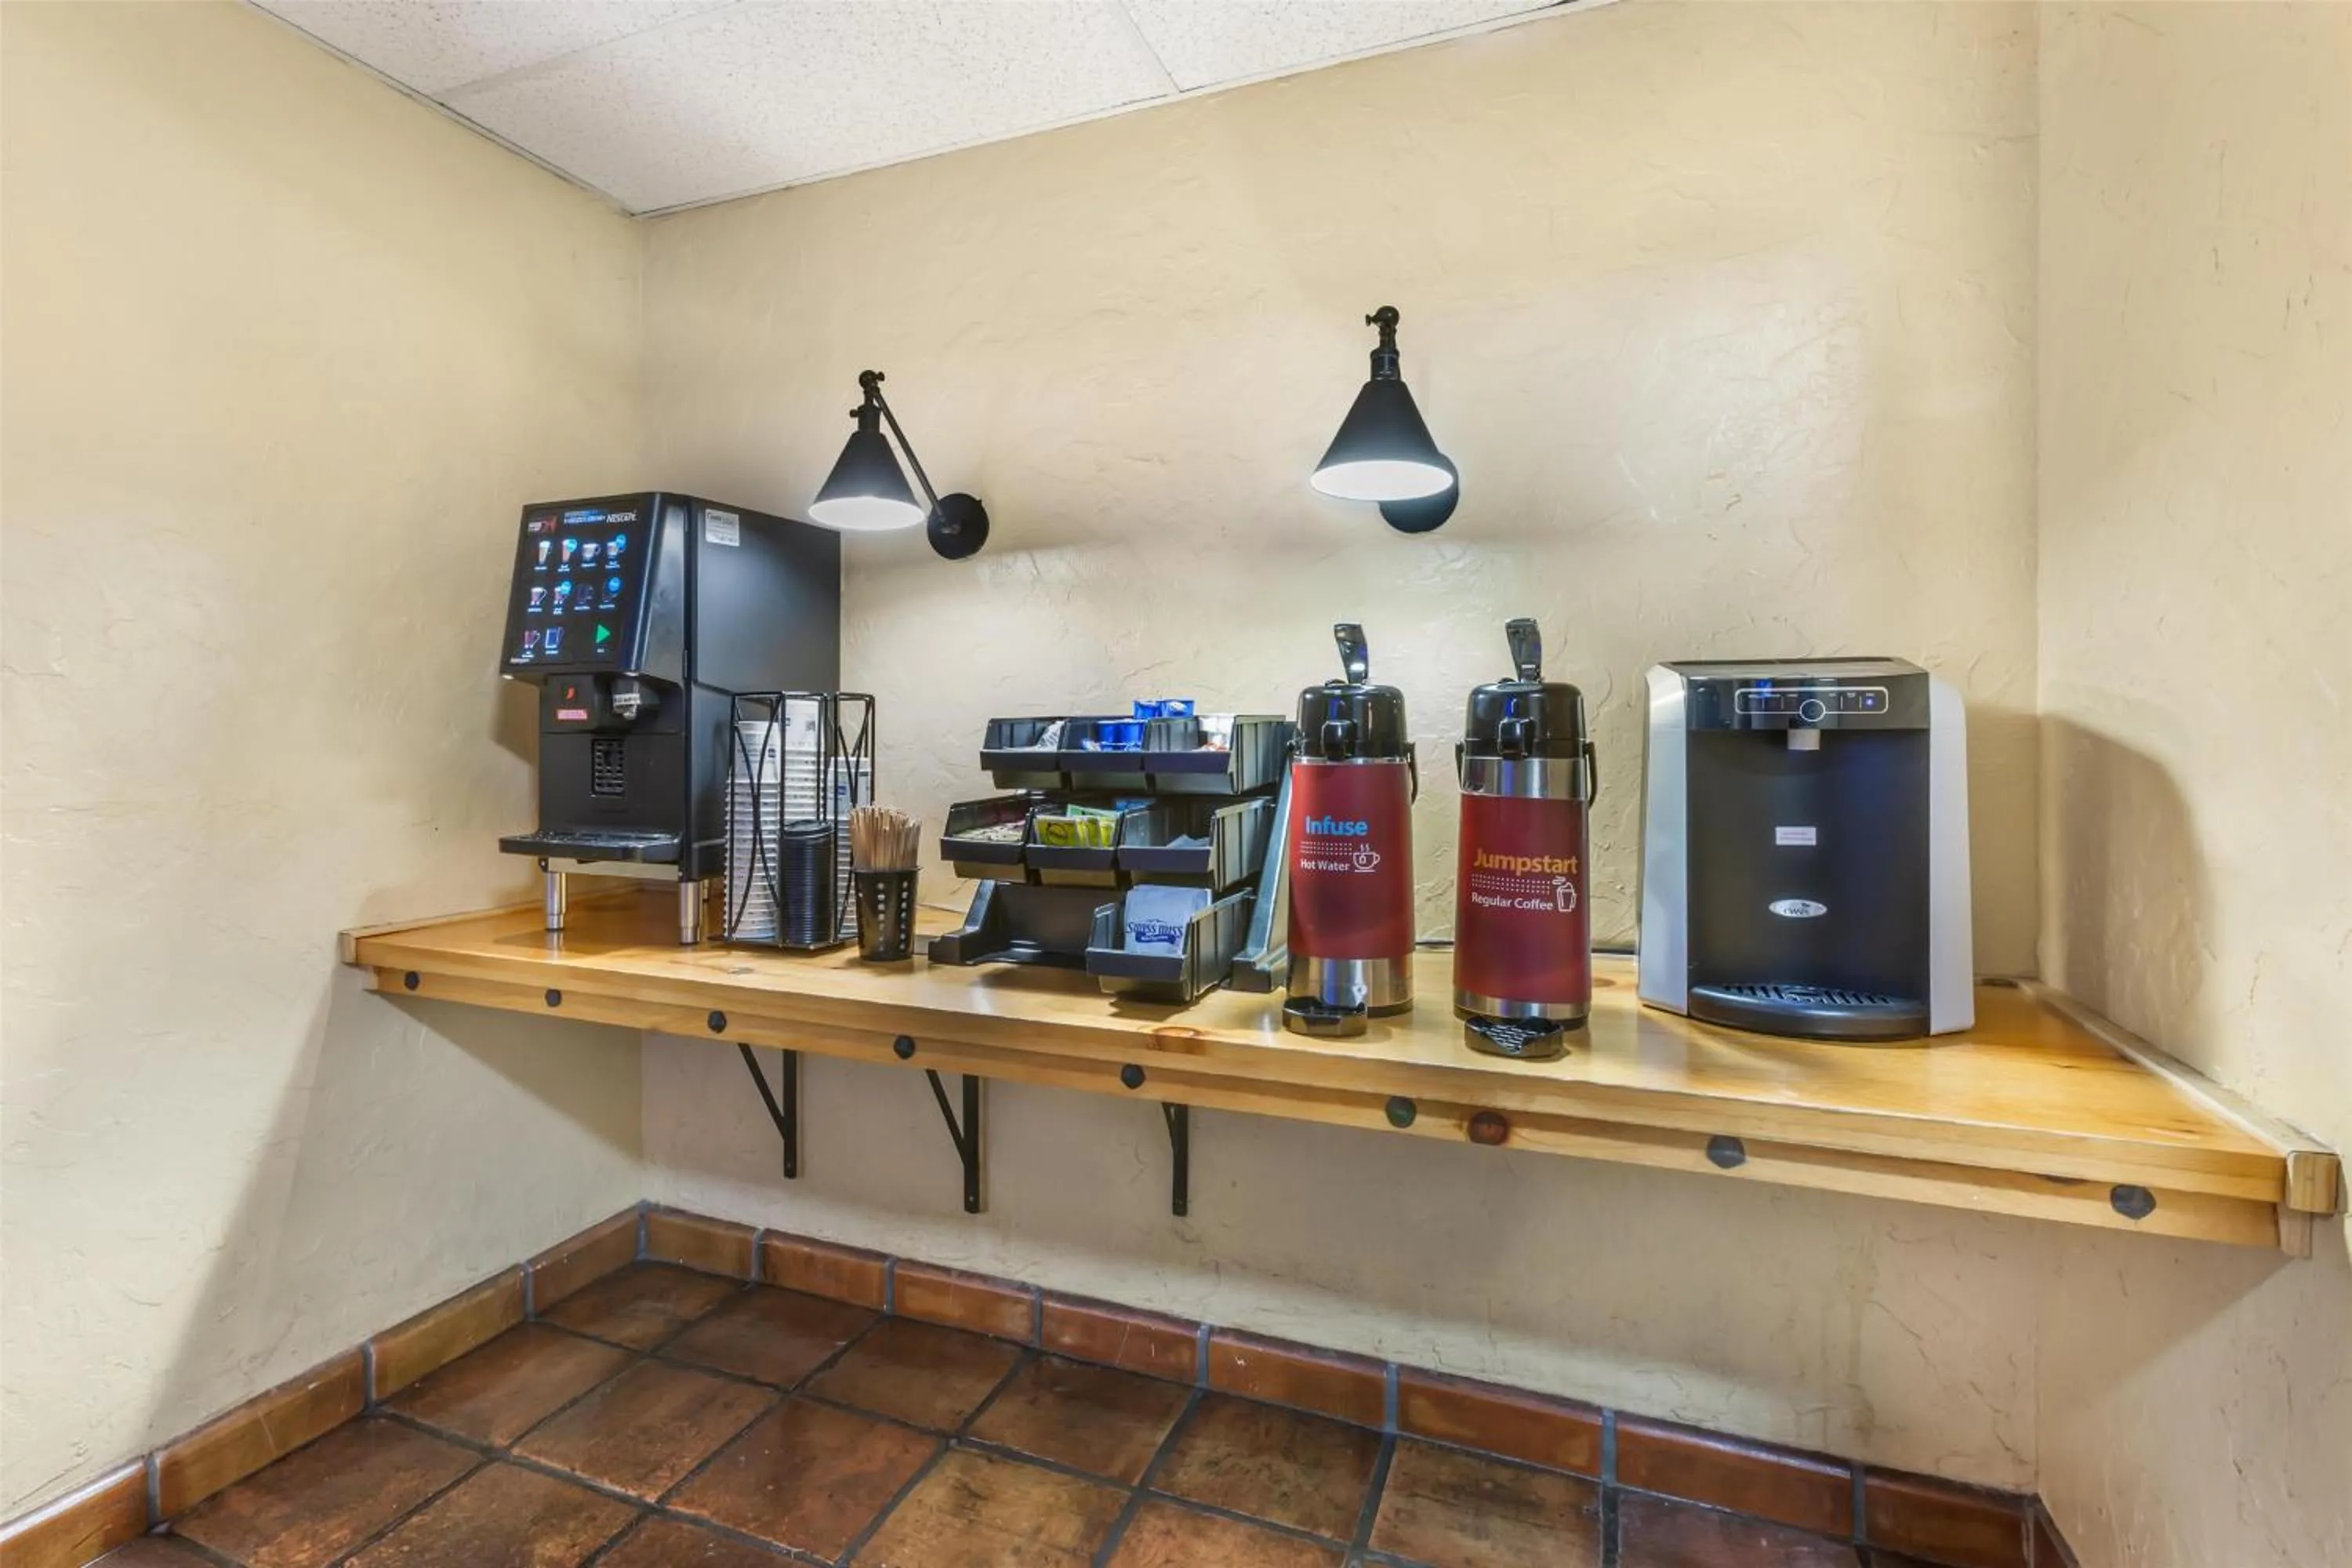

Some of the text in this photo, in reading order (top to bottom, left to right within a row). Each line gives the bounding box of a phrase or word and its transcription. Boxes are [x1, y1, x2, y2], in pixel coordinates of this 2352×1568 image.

[1305, 815, 1368, 837] Infuse
[1301, 859, 1350, 872] Hot Water
[1474, 848, 1578, 876] Jumpstart
[1472, 891, 1554, 910] Regular Coffee
